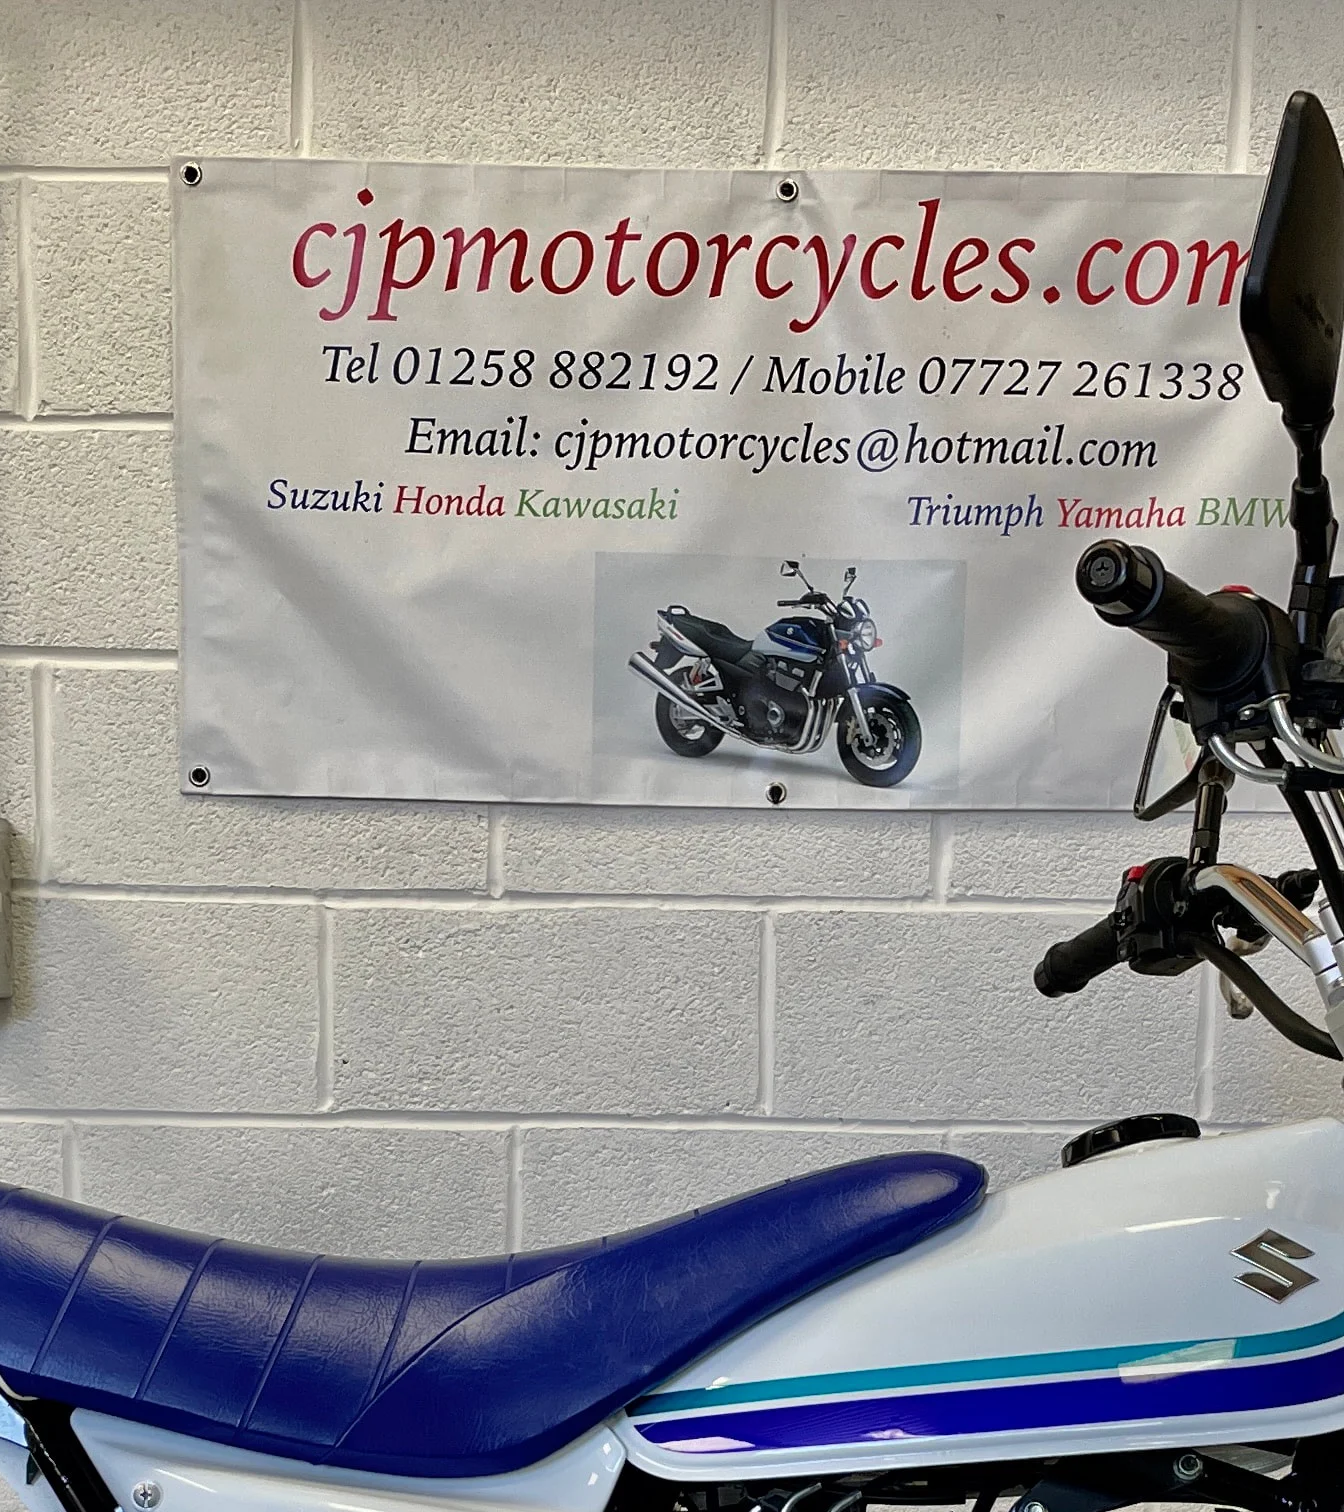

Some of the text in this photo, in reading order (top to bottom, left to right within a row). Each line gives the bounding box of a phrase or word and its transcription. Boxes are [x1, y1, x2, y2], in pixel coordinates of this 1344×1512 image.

[291, 188, 1252, 333] cjpmotorcycles.com
[321, 341, 1244, 401] Tel 01258 882192 / Mobile 07727 261338
[404, 414, 1159, 474] Email: cjpmotorcycles@hotmail.com
[266, 478, 679, 521] Suzuki Honda Kawasaki
[907, 493, 1292, 532] Triumph Yamaha BMW
